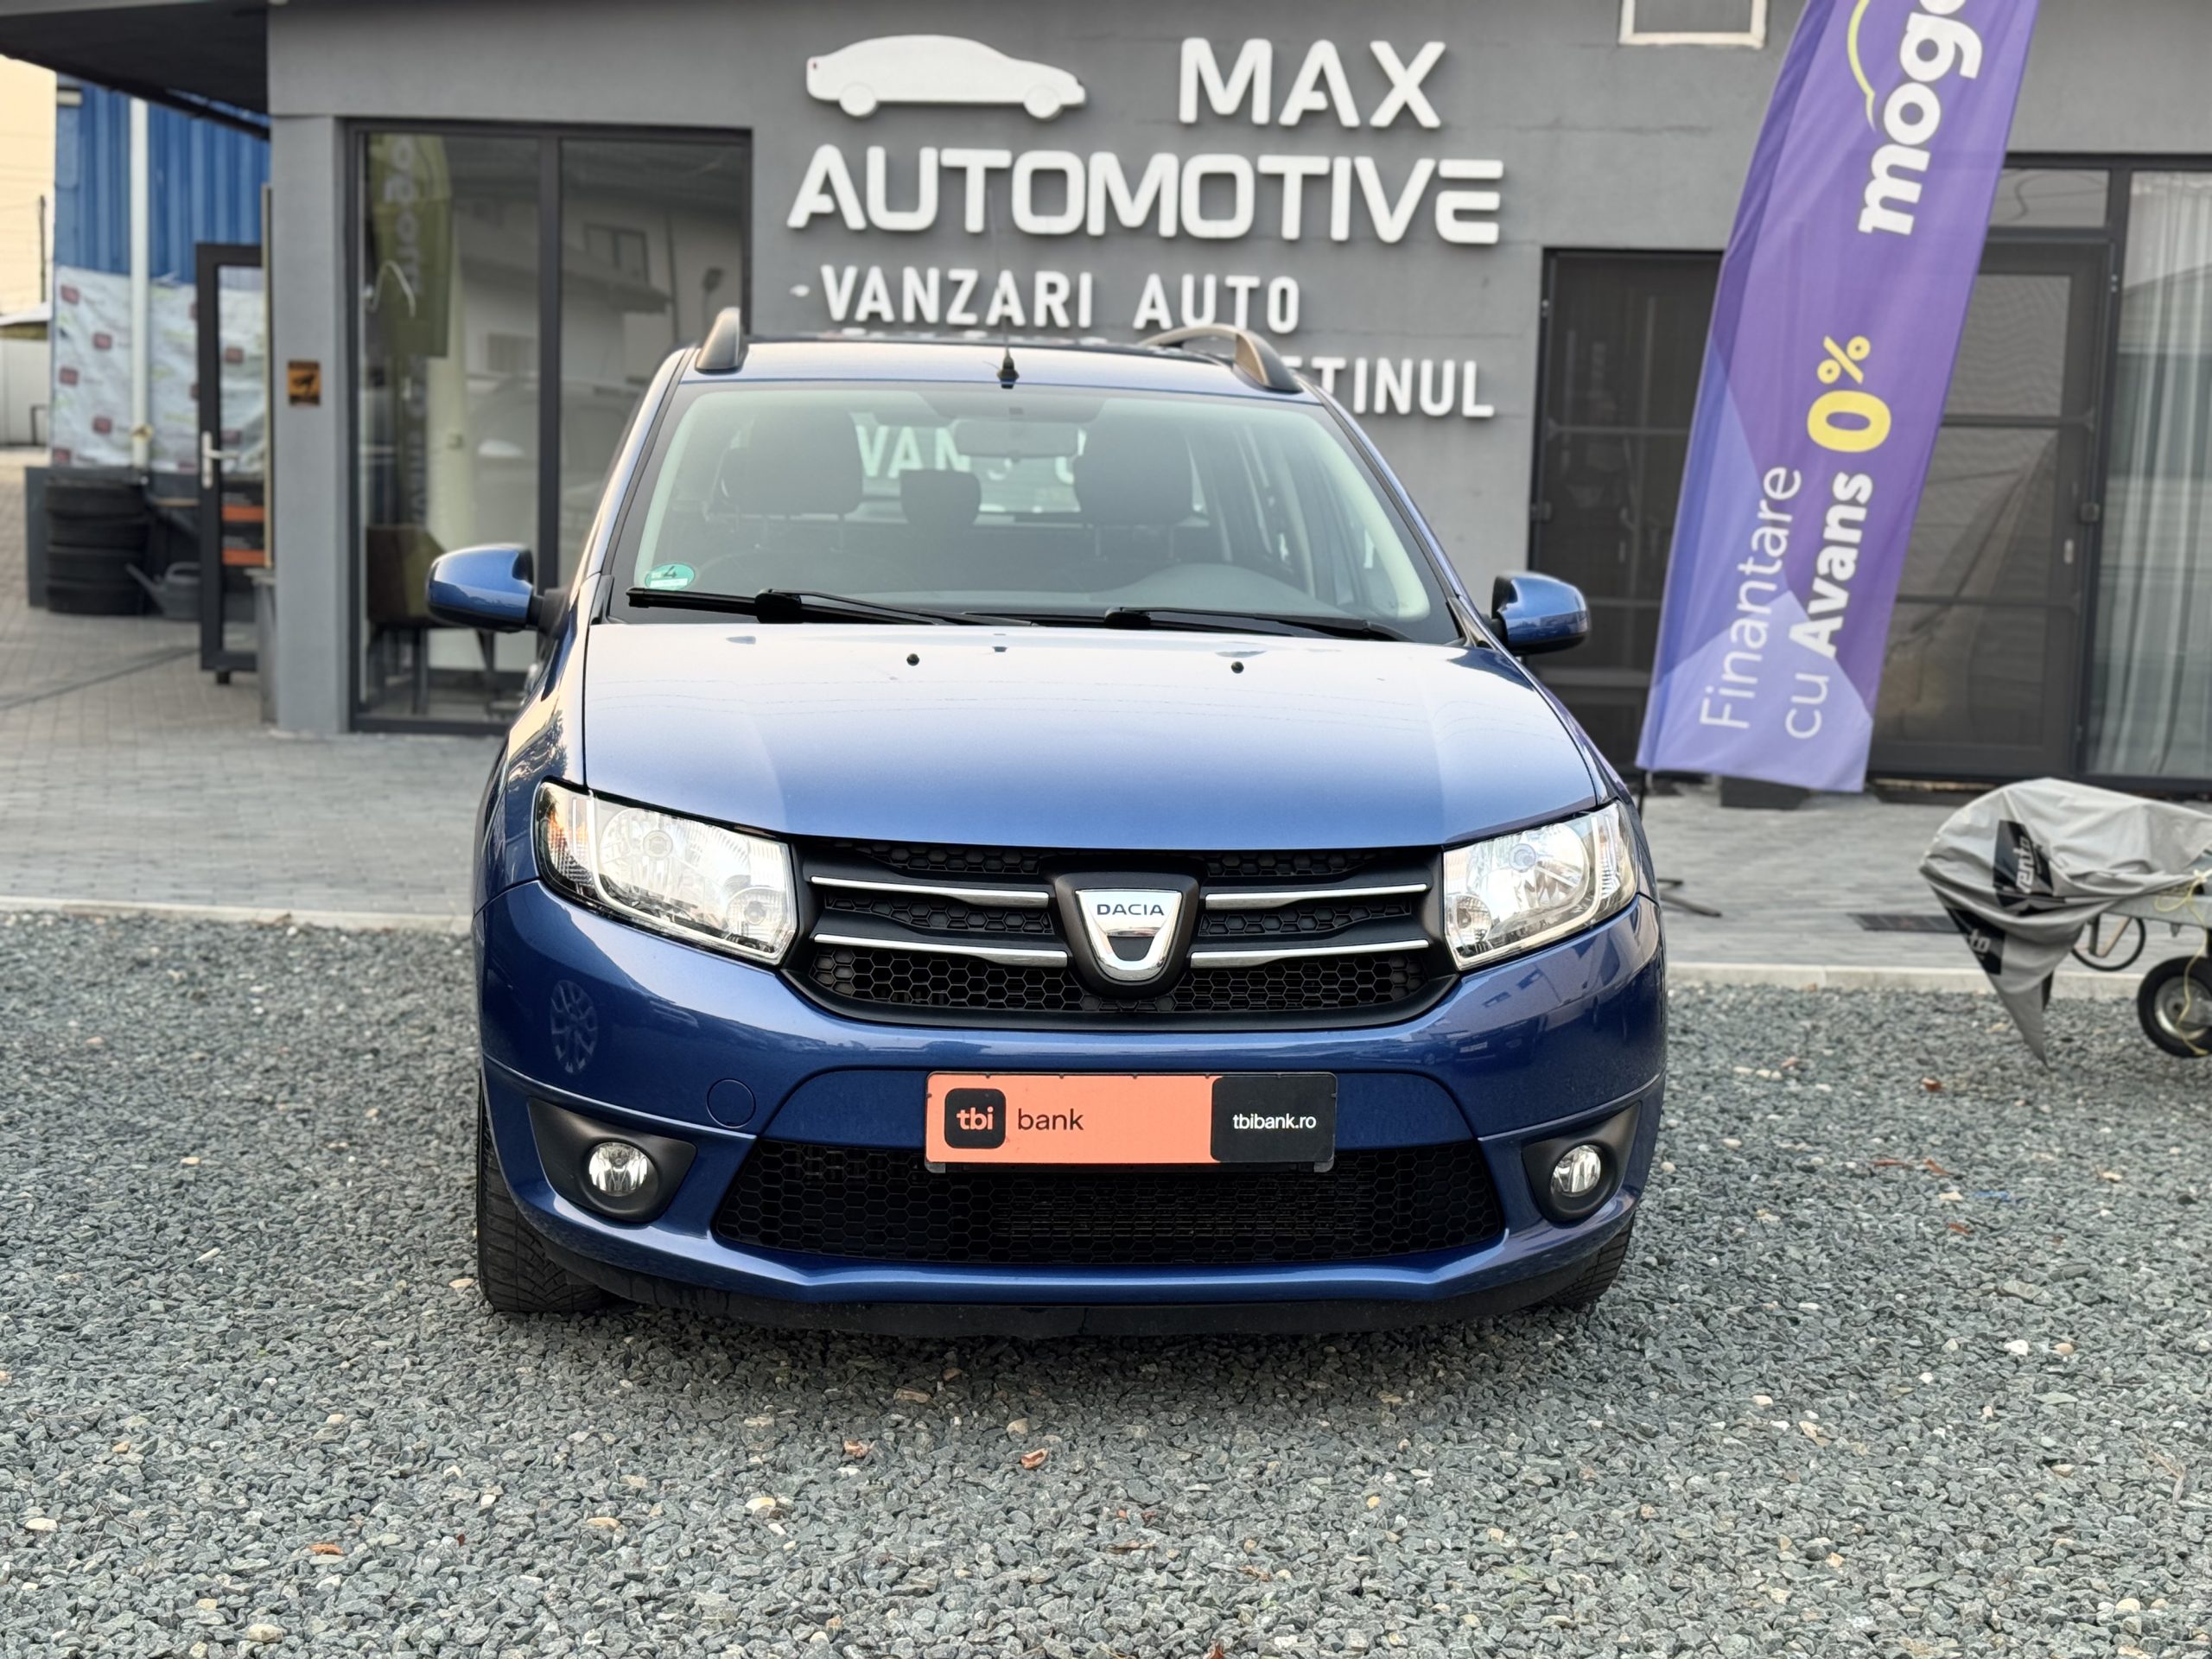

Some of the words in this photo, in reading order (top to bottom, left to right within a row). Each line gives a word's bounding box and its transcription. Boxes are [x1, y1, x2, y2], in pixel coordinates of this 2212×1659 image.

[1179, 37, 1446, 129] MAX
[1858, 0, 1983, 235] mog
[787, 143, 1503, 245] AUTOMOTIVE
[1133, 272, 1300, 334] AUTO
[1280, 355, 1495, 417] TINUL
[1807, 335, 1891, 453] 0%
[1700, 467, 1802, 728] Finantare
[1789, 472, 1873, 659] Avans
[1785, 672, 1830, 739] cu
[1096, 904, 1165, 916] DACIA
[956, 1107, 994, 1131] tbi
[1017, 1109, 1084, 1131] bank
[1233, 1113, 1318, 1130] tbibank.ro
